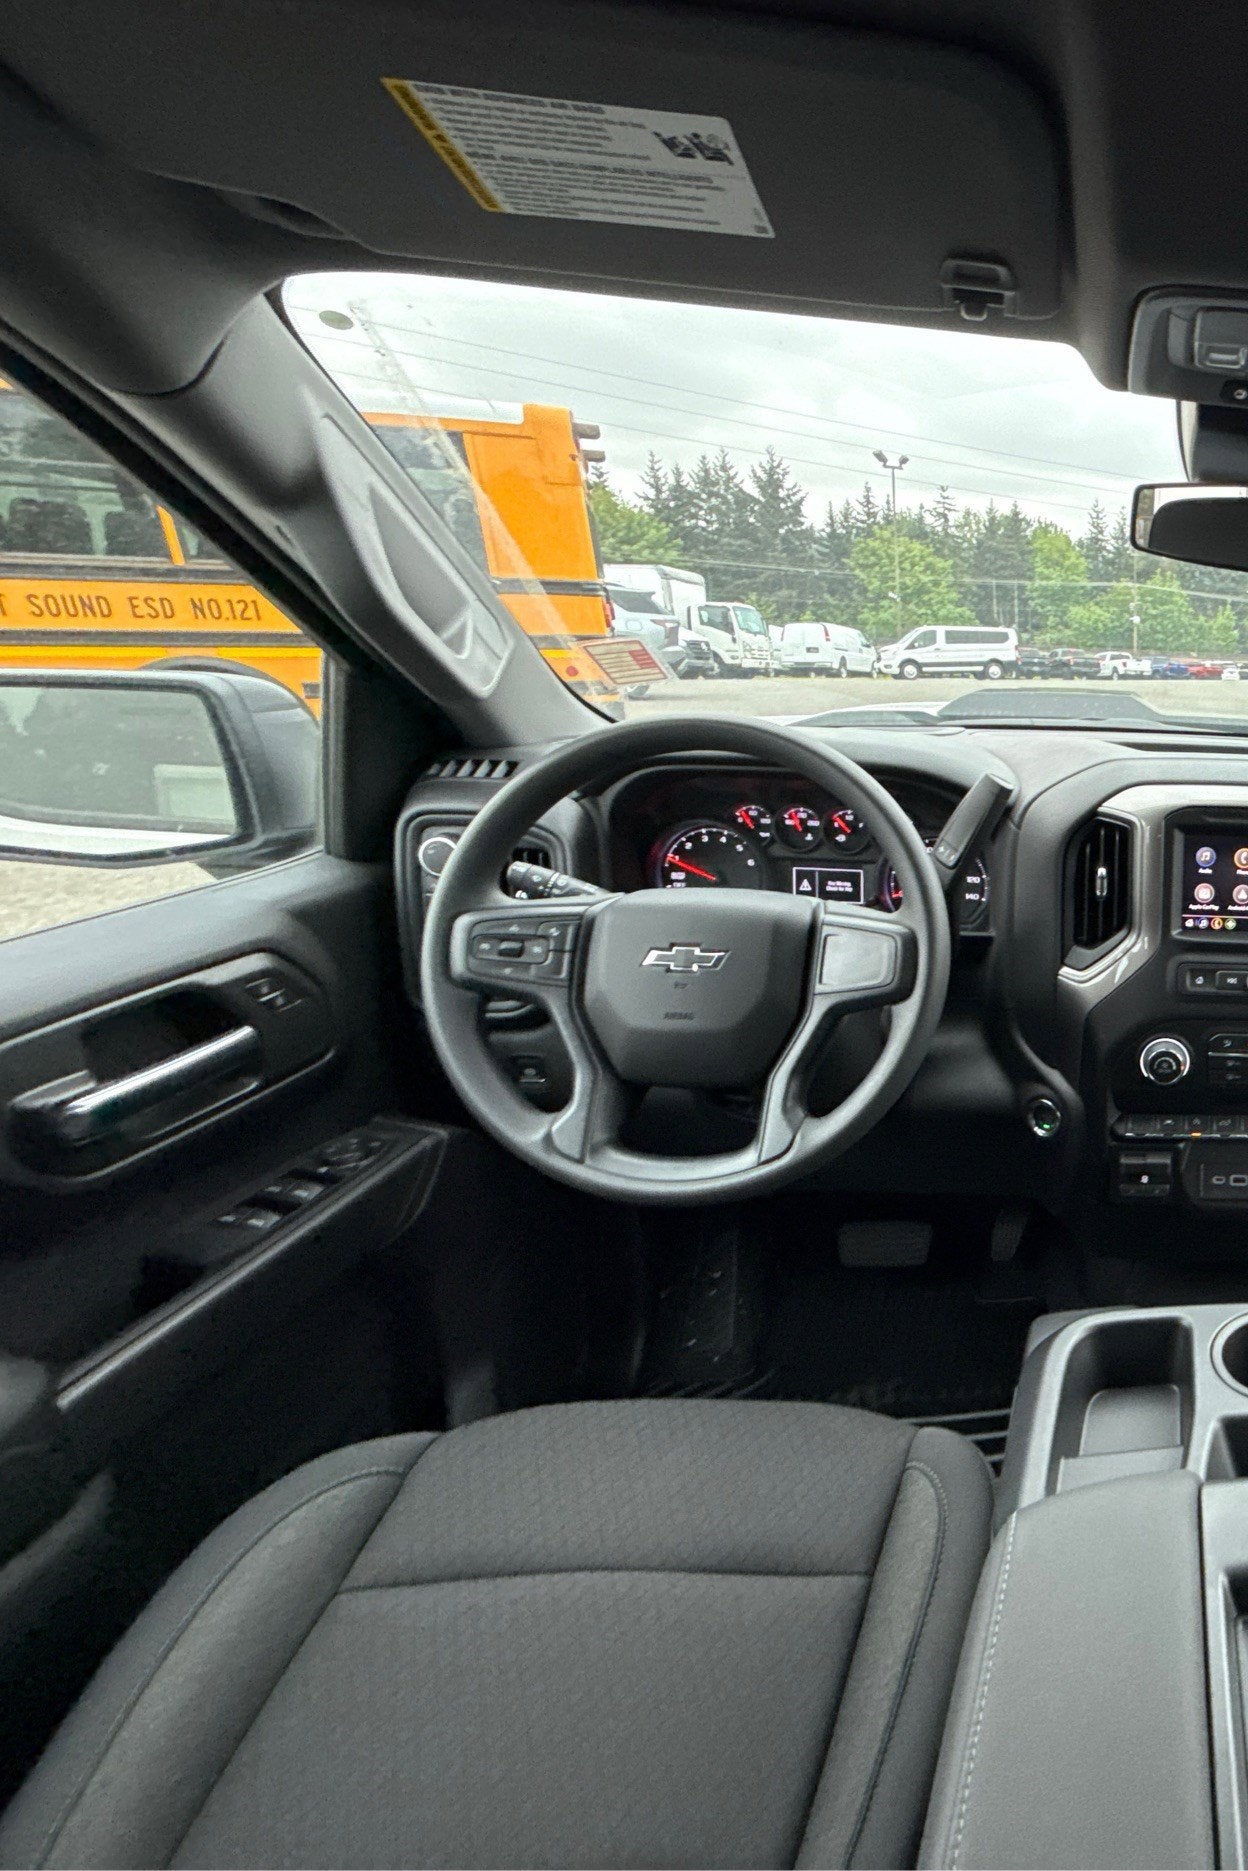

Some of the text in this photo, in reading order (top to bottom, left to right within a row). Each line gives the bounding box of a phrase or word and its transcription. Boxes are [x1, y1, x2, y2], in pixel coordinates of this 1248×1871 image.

[26, 593, 112, 618] SOUND
[127, 595, 175, 619] ESD
[190, 597, 262, 621] NO.121
[701, 834, 709, 842] 3
[684, 842, 693, 850] 2
[735, 844, 744, 852] 5
[747, 859, 755, 867] 6
